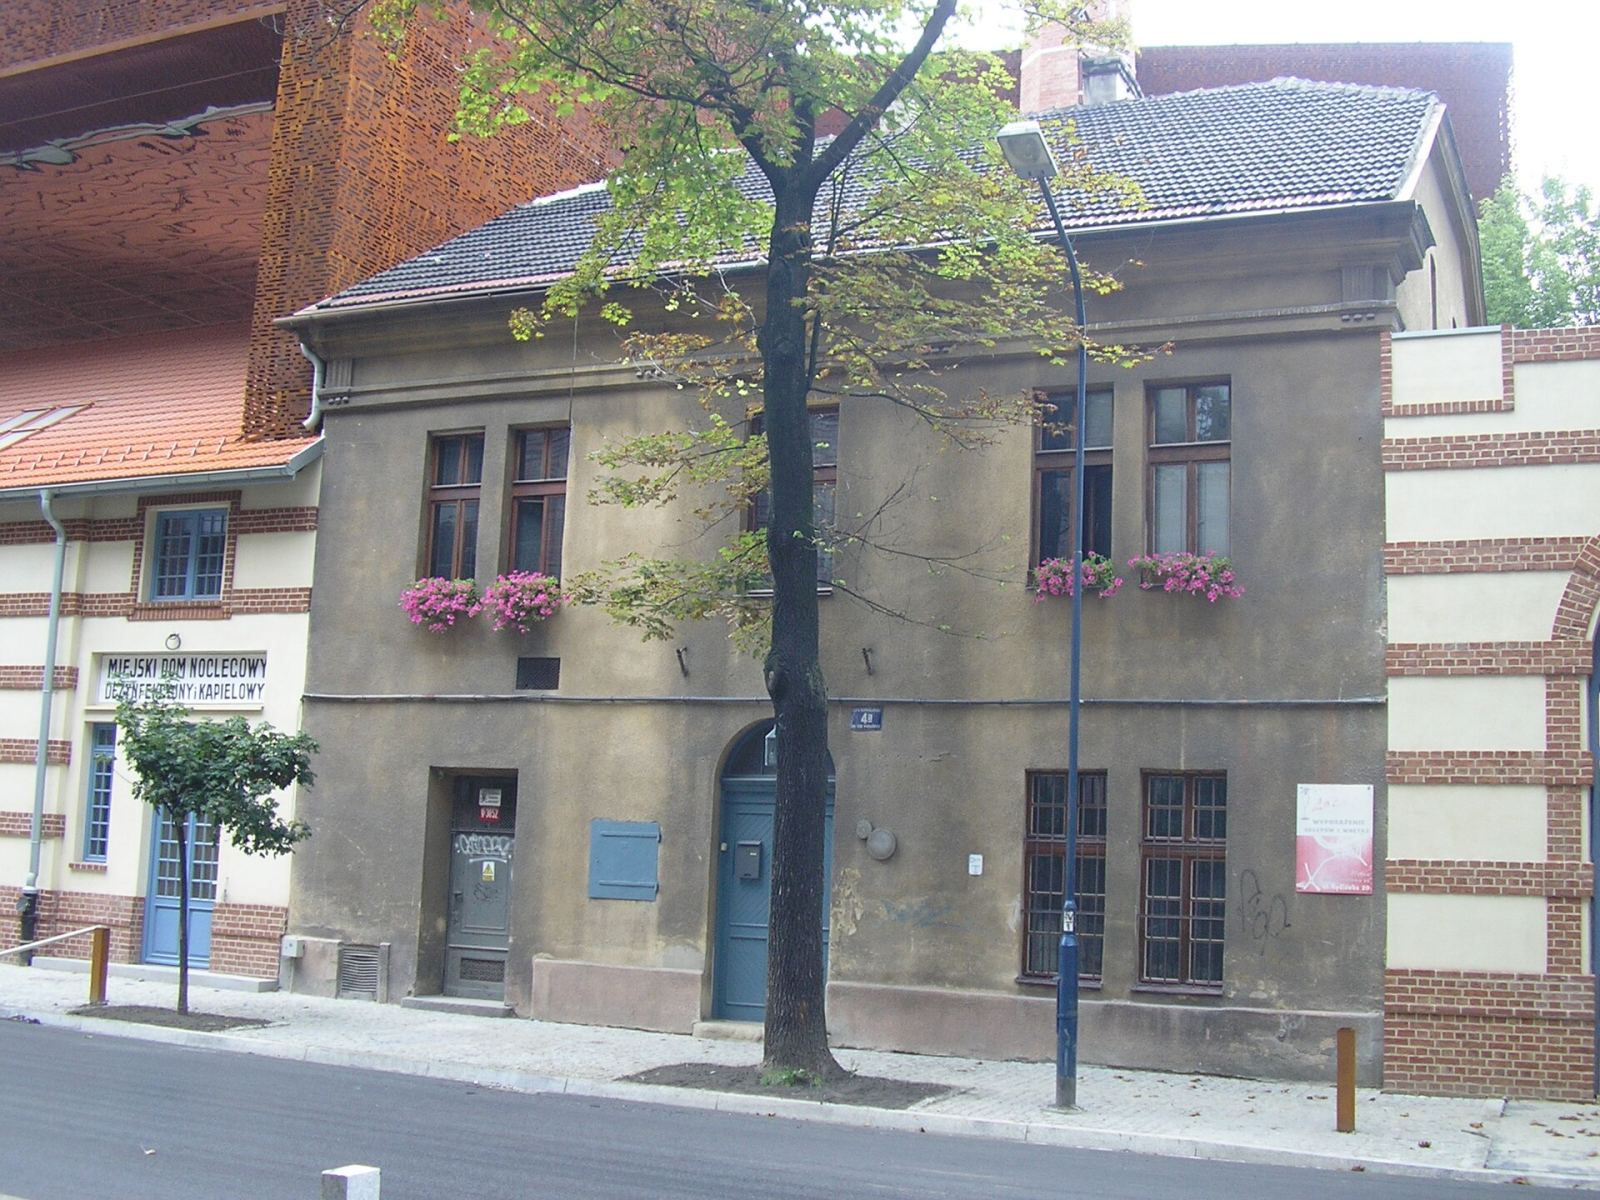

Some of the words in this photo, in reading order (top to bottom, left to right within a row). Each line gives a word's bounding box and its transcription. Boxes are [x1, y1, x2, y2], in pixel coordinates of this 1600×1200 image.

[107, 657, 157, 679] MIEJSKI
[161, 657, 187, 679] DOM
[189, 656, 267, 679] NOCLEGOWY
